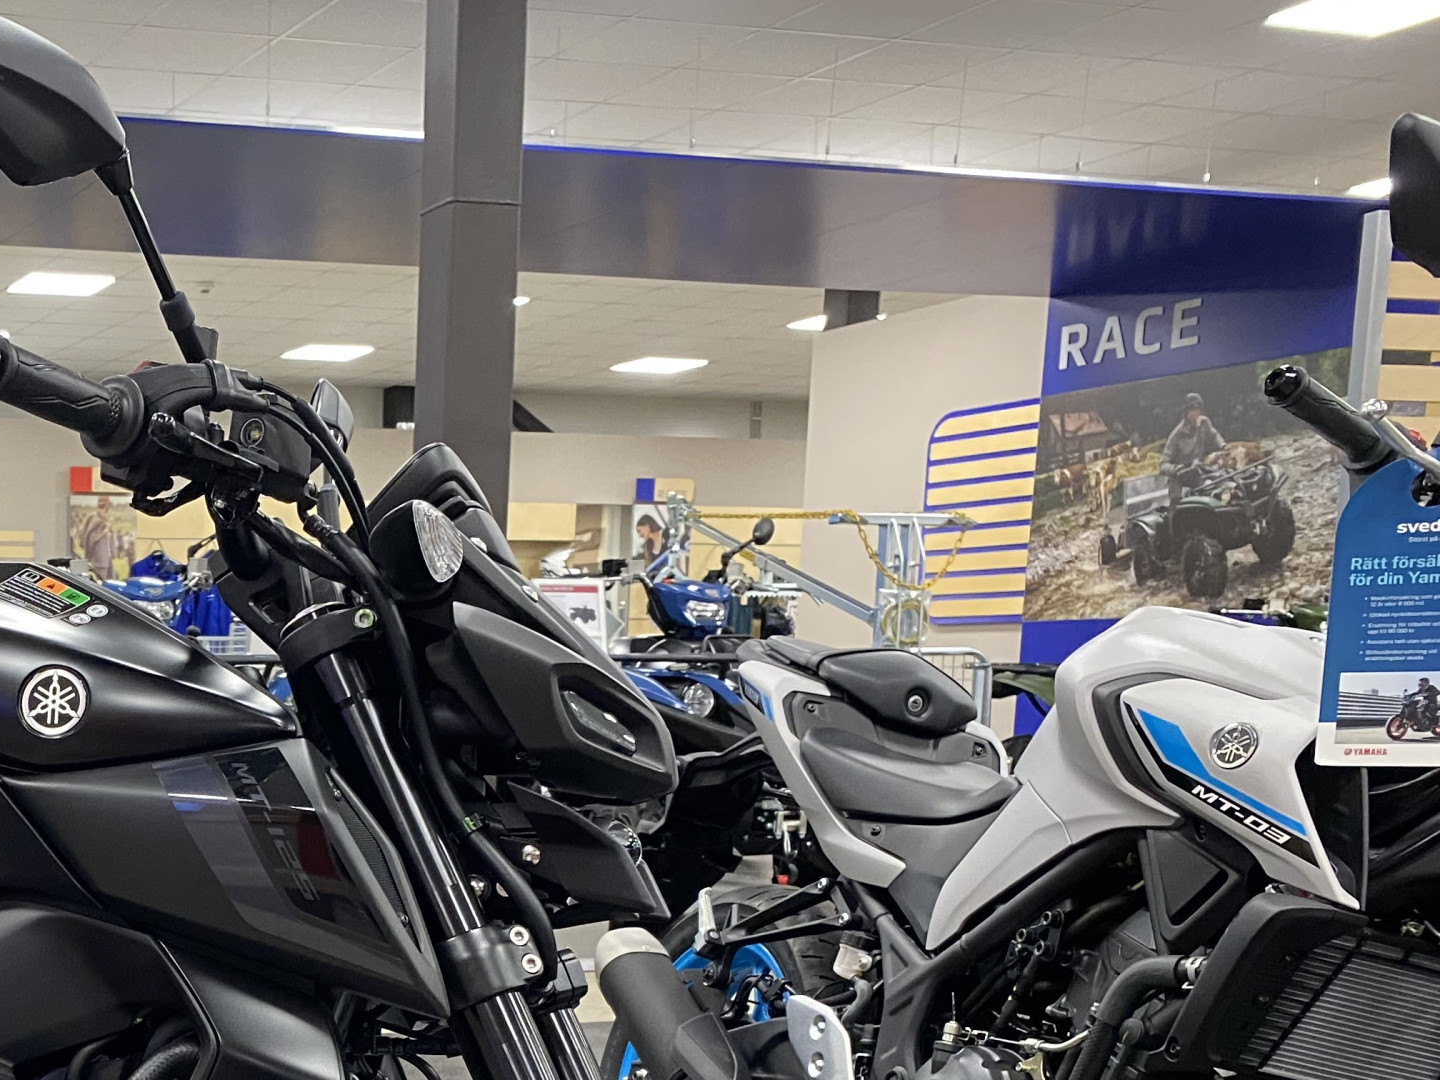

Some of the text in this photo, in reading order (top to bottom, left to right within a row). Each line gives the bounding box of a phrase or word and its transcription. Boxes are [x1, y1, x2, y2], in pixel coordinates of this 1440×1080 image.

[1059, 298, 1203, 370] RACE
[1351, 557, 1387, 570] Rätt
[1349, 573, 1373, 586] för
[1378, 571, 1404, 585] din
[1353, 748, 1387, 756] YAMAHA
[1191, 784, 1292, 845] MT-03
